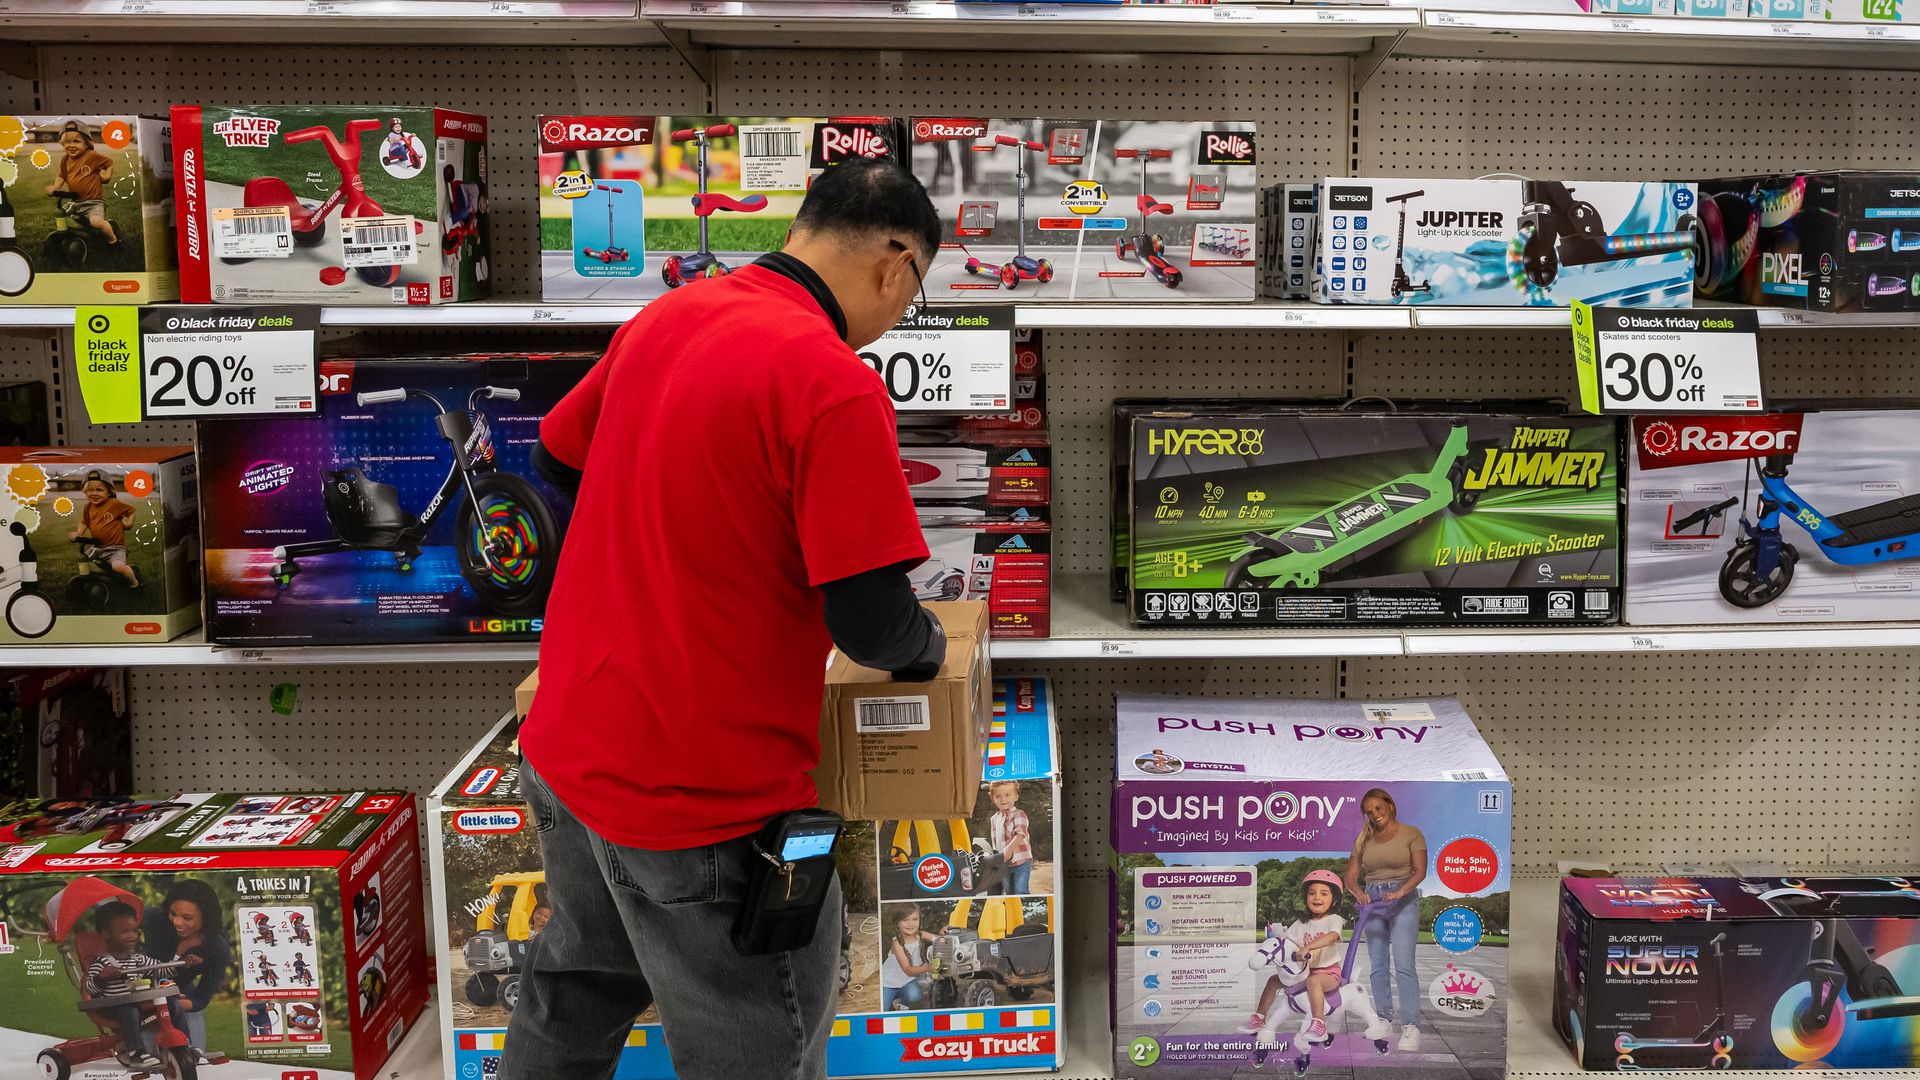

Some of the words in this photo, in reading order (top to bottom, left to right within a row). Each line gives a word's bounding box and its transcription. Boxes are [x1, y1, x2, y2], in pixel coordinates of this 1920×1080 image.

[231, 119, 277, 132] FLYER
[933, 124, 985, 136] Razor
[223, 133, 268, 146] TRIKE
[821, 126, 889, 161] Rollie
[1207, 134, 1253, 158] Rollie
[184, 149, 196, 199] FLYER
[554, 186, 593, 195] CONVERTIBLE
[1677, 193, 1690, 202] 5+
[1416, 211, 1504, 229] JUPITER
[1417, 228, 1452, 238] Light-Up
[1471, 229, 1502, 237] Scooter
[278, 236, 288, 247] M
[1762, 253, 1808, 285] PIXEL
[1819, 287, 1831, 298] 12+
[181, 315, 216, 328] black
[218, 315, 256, 330] friday
[258, 316, 293, 327] deals
[918, 315, 953, 329] friday
[956, 315, 989, 326] deals
[1631, 316, 1664, 329] black
[1665, 317, 1700, 331] friday
[1702, 318, 1735, 330] deals
[147, 335, 163, 343] Non
[166, 335, 197, 343] electric
[199, 335, 221, 345] riding
[224, 335, 242, 344] toys
[900, 331, 922, 341] riding
[924, 332, 941, 341] toys
[1602, 332, 1629, 341] Skates
[1630, 332, 1646, 341] and
[1648, 333, 1681, 341] scooters
[88, 339, 127, 350] black
[89, 351, 130, 363] friday
[88, 362, 128, 372] deals
[225, 387, 256, 405] off
[921, 384, 952, 402] off
[1676, 385, 1705, 402] off
[1149, 429, 1238, 455] HYPER
[1240, 429, 1265, 443] TOY
[1511, 427, 1570, 449] HYPER
[1681, 426, 1797, 450] Razor
[245, 468, 265, 477] DRIFT
[266, 464, 283, 472] WITH
[1463, 449, 1605, 490] JAMMER
[239, 466, 295, 488] ANIMATED
[1021, 479, 1034, 488] 5+
[1155, 506, 1168, 518] 10
[1167, 510, 1184, 518] MPH
[1199, 506, 1215, 518] 40
[1215, 510, 1229, 518] MIN
[1238, 506, 1260, 518] 6-8
[1260, 509, 1275, 518] HRS
[1338, 503, 1388, 532] JAMMER
[1797, 508, 1821, 530] E95
[1435, 548, 1451, 567] 12
[1455, 544, 1483, 564] Volt
[1486, 538, 1542, 561] Electric
[1547, 533, 1606, 553] Scooter
[1155, 553, 1173, 564] AGE
[1174, 552, 1203, 577] 8+
[1485, 597, 1502, 608] RIDE
[1504, 598, 1527, 608] RIGHT
[1014, 614, 1028, 624] 5+
[469, 619, 544, 633] LIGHTS
[1192, 762, 1236, 771] CRYSTAL
[461, 817, 488, 826] little
[490, 815, 517, 825] tikes
[1157, 831, 1209, 847] Imagined
[1215, 830, 1229, 845] By
[1235, 830, 1259, 841] Kids
[1265, 829, 1282, 841] for
[921, 862, 944, 873] Flatbed
[1445, 857, 1467, 866] Ride,
[1469, 857, 1490, 866] Spin,
[926, 869, 940, 877] with
[1444, 866, 1467, 875] Push,
[1469, 866, 1491, 876] Play!
[237, 877, 247, 894] 4
[250, 878, 286, 892] TRIKES
[288, 878, 300, 890] IN
[304, 876, 311, 893] 1
[923, 875, 946, 885] Tailgate
[1188, 875, 1237, 883] POWERED
[465, 893, 500, 918] HONK!
[1444, 929, 1457, 937] you
[1607, 946, 1698, 958] SUPER
[1606, 959, 1698, 975] NOVA
[918, 1039, 972, 1061] Cozy
[1134, 1044, 1154, 1060] 2+
[1166, 1043, 1183, 1051] Fun
[1186, 1042, 1200, 1051] for
[1204, 1042, 1219, 1051] the
[1223, 1042, 1252, 1050] entire
[1255, 1041, 1288, 1053] family!
